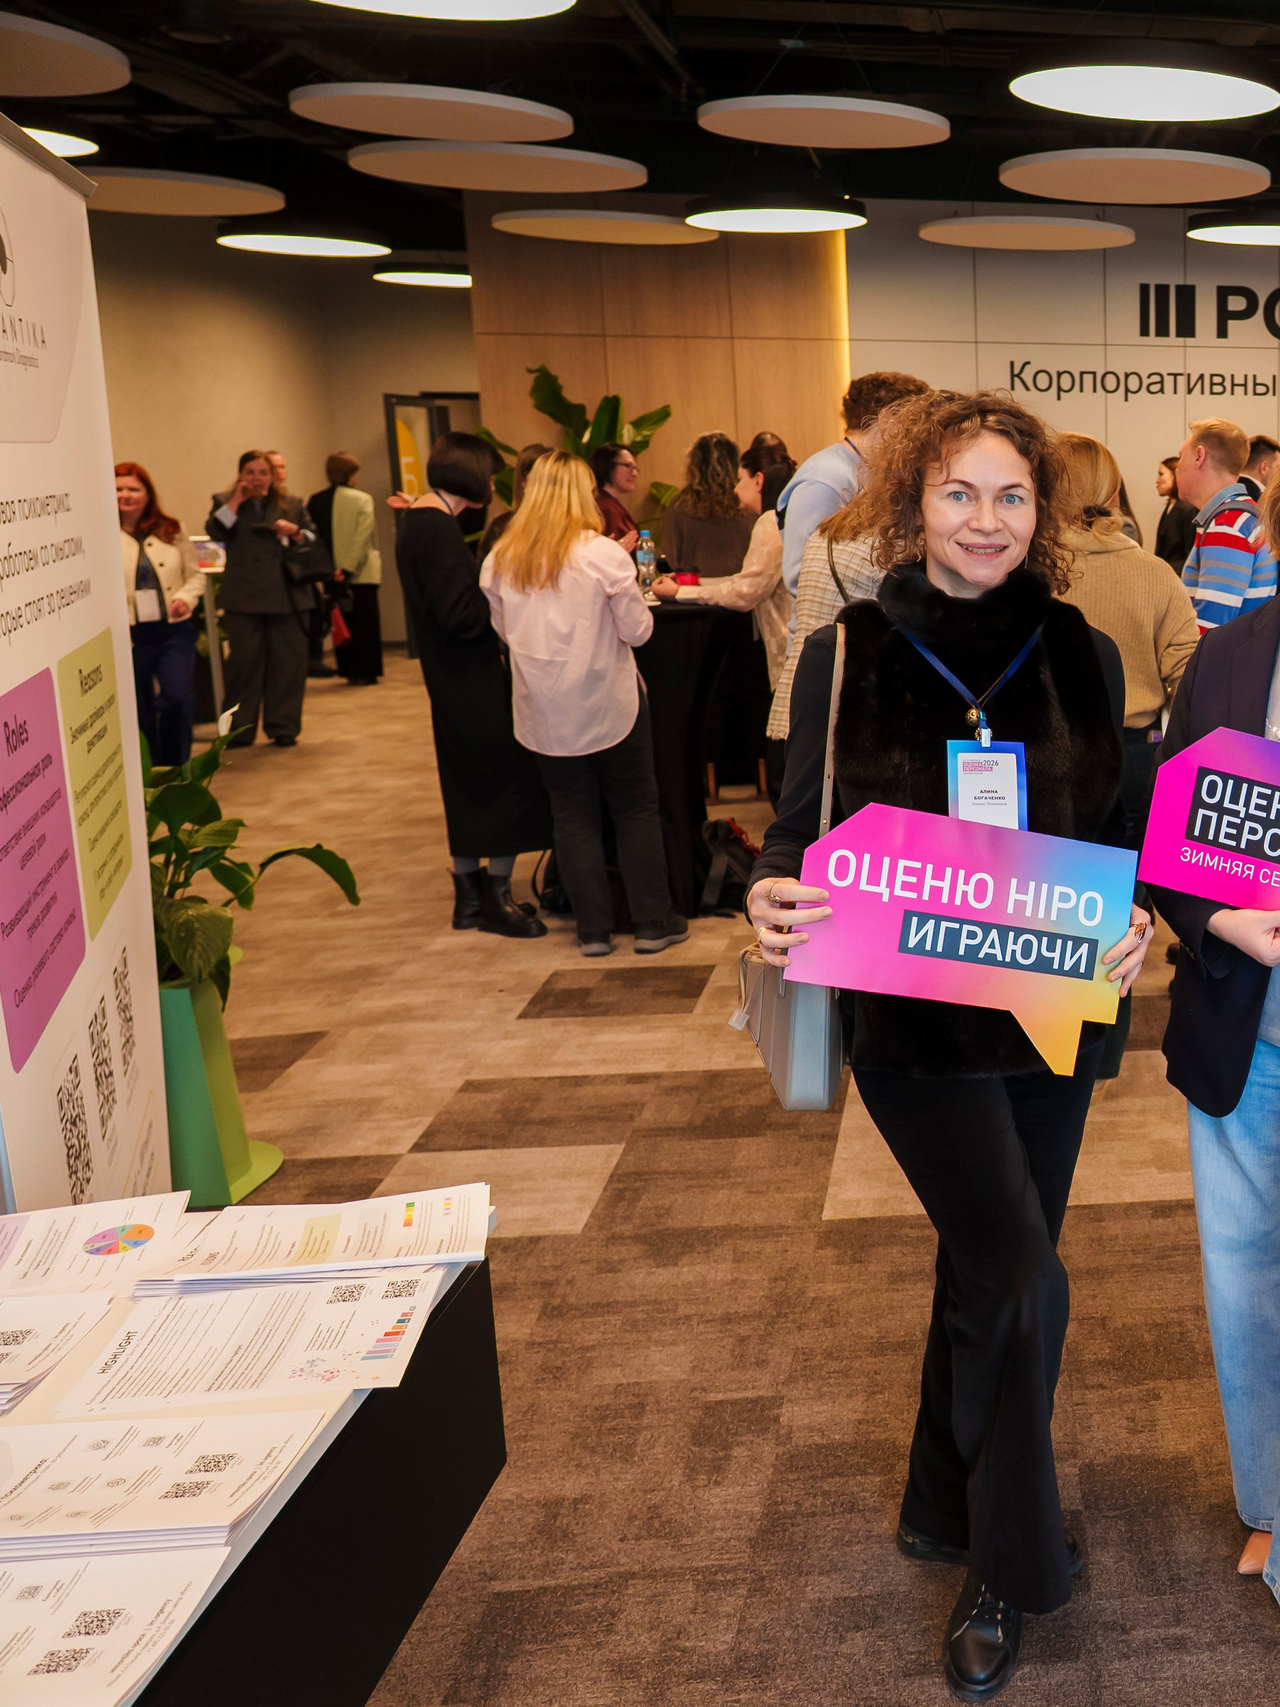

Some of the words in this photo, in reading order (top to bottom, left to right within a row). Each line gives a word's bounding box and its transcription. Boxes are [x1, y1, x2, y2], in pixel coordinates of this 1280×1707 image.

[0, 606, 24, 646] орые
[4, 714, 29, 757] Roles
[983, 759, 999, 767] 2026
[827, 849, 994, 909] ОЦЕНЮ
[1180, 847, 1255, 880] ЗИМНЯЯ
[907, 916, 1090, 973] ИГРАЮЧИ
[97, 1331, 138, 1375] HIGHLIGHT
